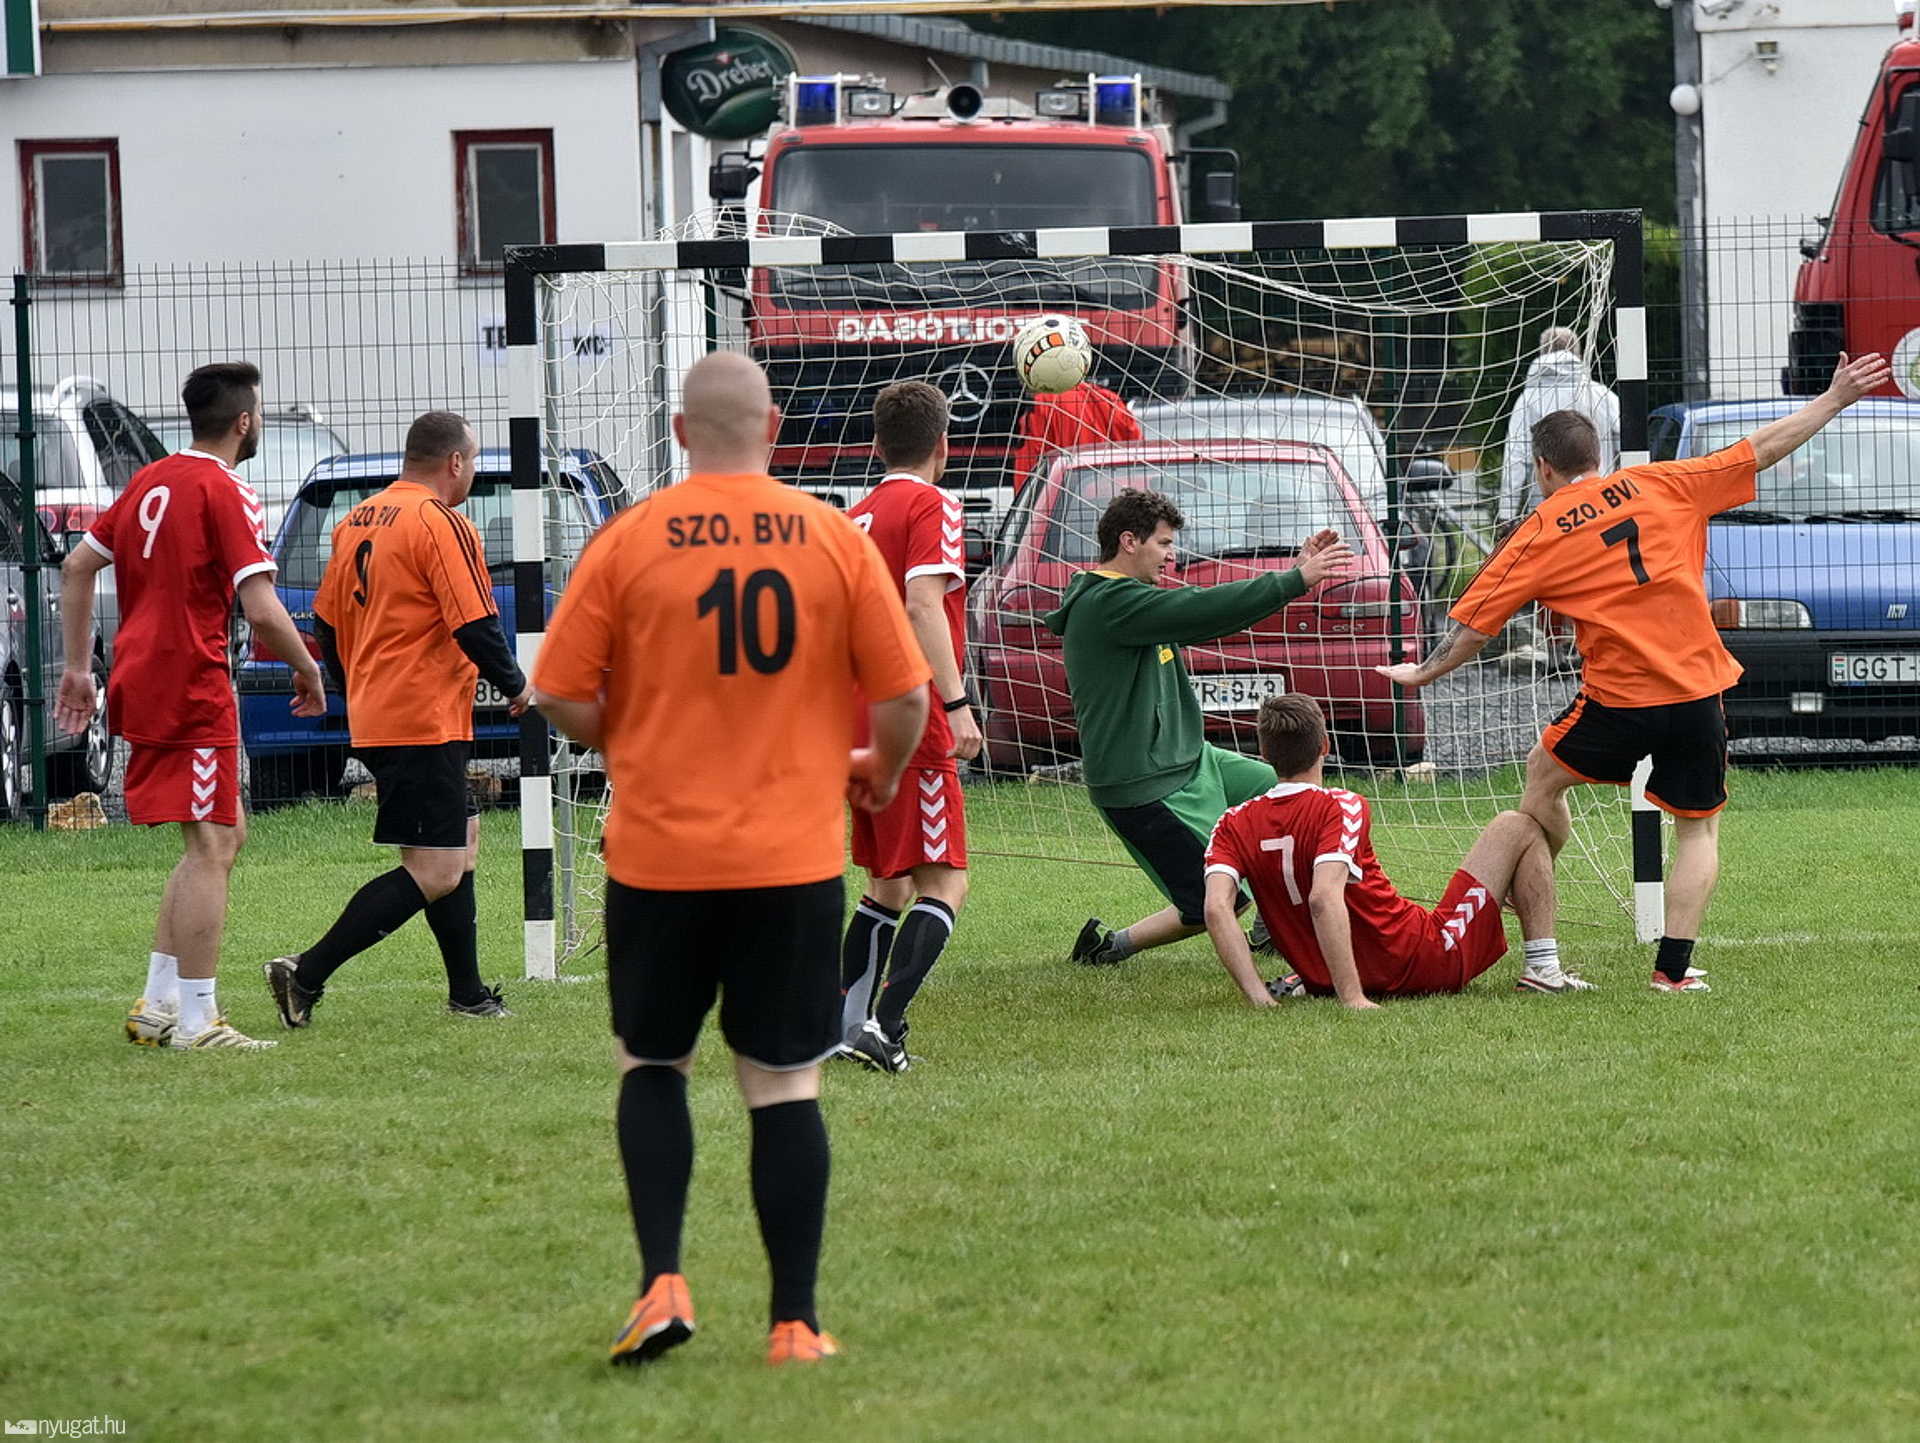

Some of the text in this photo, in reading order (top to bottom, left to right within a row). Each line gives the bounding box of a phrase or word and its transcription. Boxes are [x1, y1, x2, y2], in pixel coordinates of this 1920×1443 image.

[686, 57, 773, 102] Dreher
[138, 485, 171, 559] 9
[667, 513, 806, 547] SZO. BVI
[1556, 479, 1641, 534] SZO. BVI
[353, 539, 373, 608] 9
[1600, 517, 1651, 586] 7
[696, 568, 797, 676] 10
[1853, 656, 1920, 680] GGT-
[1260, 834, 1304, 906] 7
